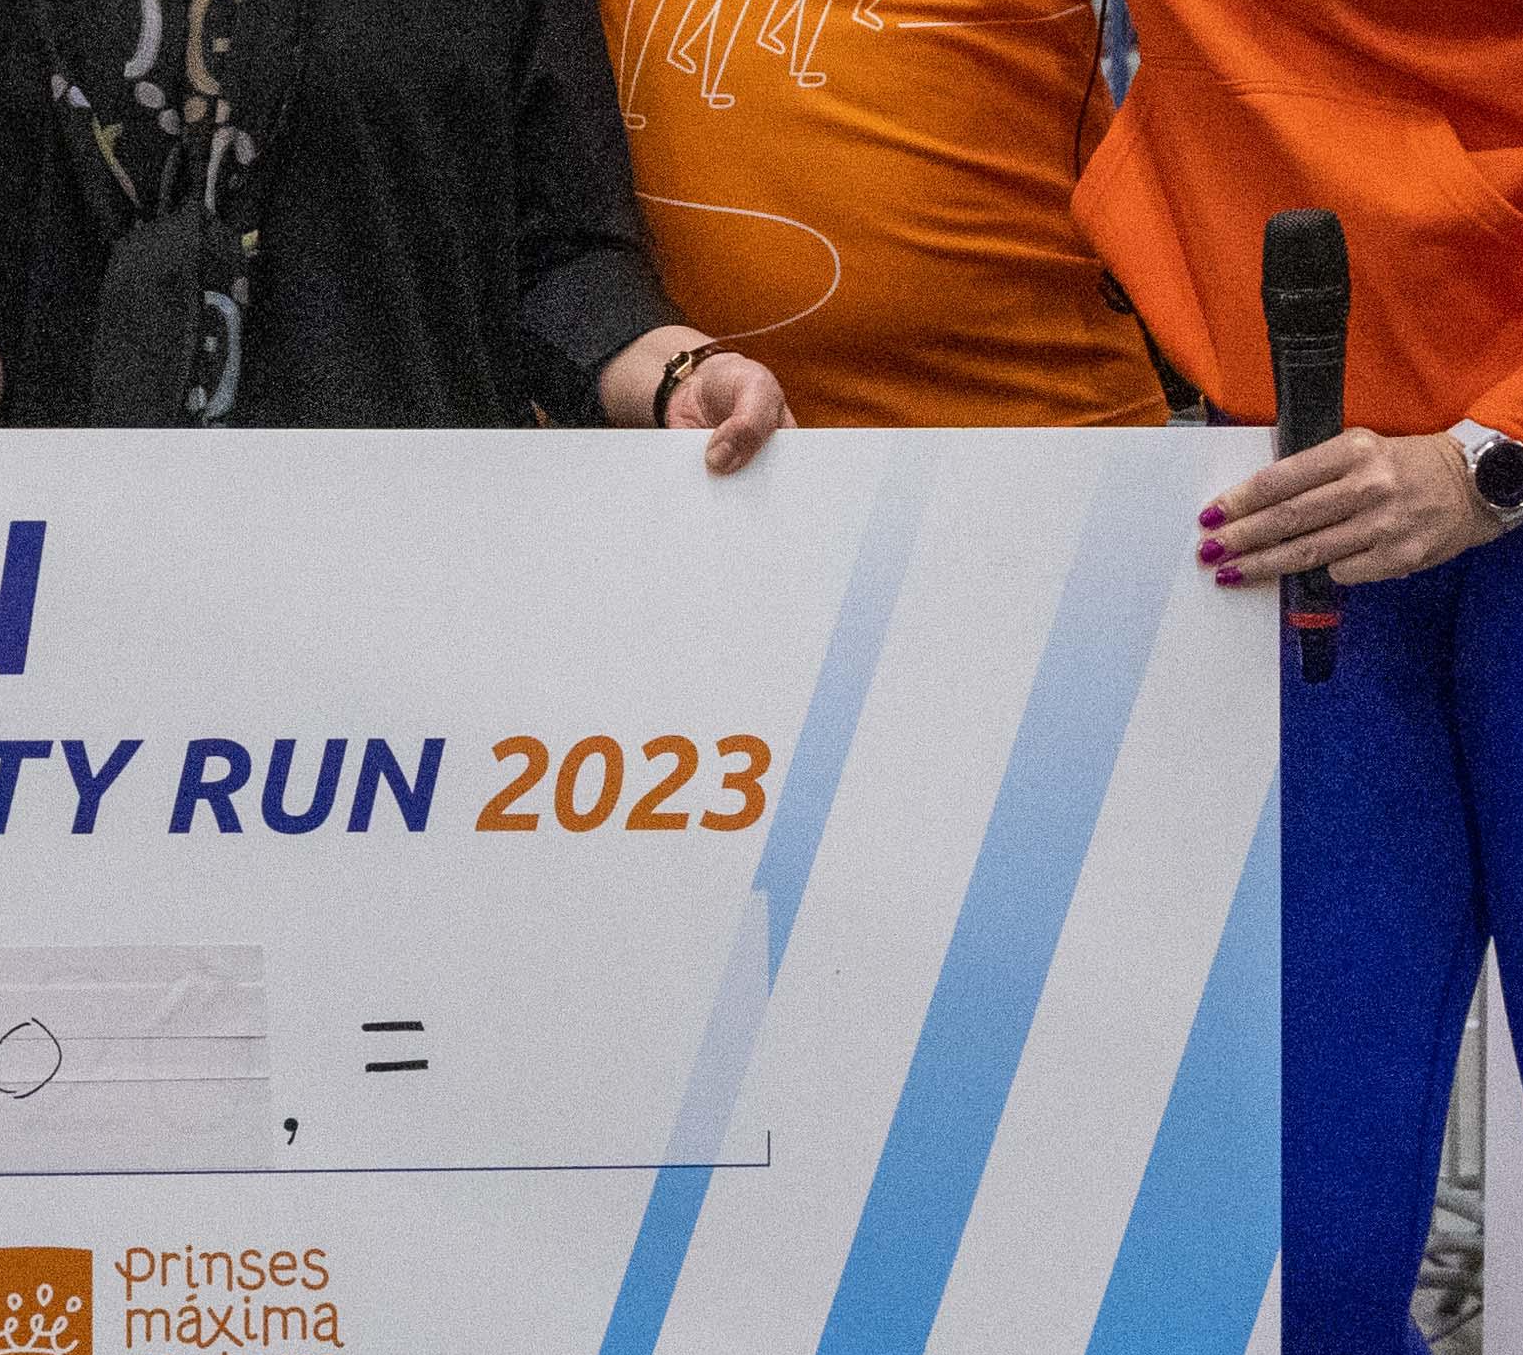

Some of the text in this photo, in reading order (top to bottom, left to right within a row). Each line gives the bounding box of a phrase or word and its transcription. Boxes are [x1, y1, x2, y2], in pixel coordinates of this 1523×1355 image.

[168, 737, 448, 836] RUN
[475, 733, 775, 834] 2023
[114, 1244, 330, 1302] prinses
[125, 1293, 345, 1349] máxima
